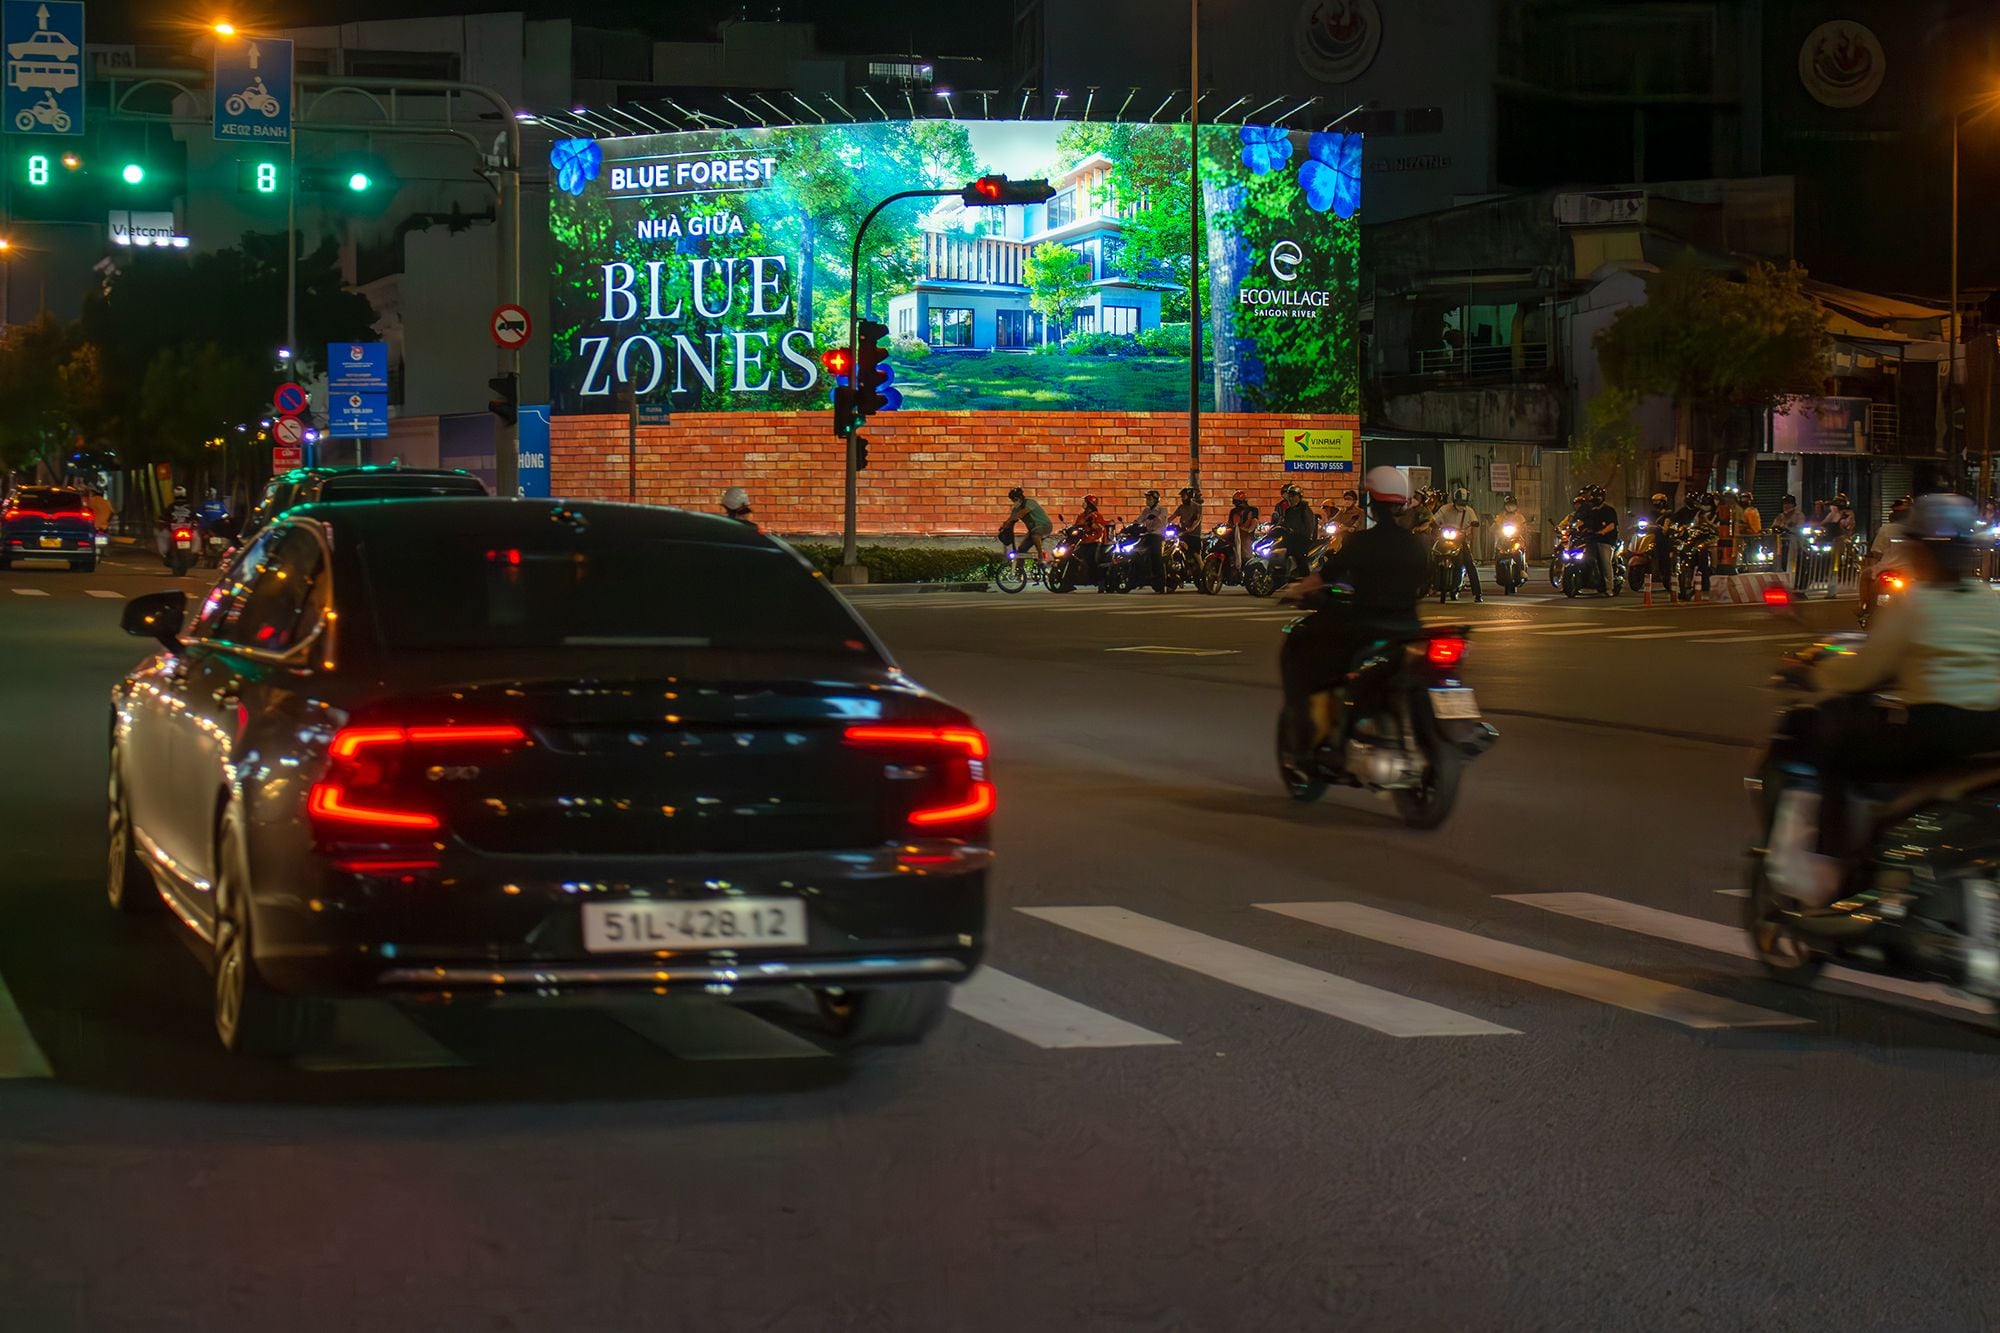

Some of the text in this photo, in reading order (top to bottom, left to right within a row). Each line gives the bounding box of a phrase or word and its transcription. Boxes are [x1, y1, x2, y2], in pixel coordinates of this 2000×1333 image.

[221, 123, 237, 135] XE
[28, 154, 48, 186] 8
[257, 163, 276, 192] 8
[611, 158, 776, 190] BLUE FOREST
[637, 211, 744, 239] NHÀ GIỮA
[600, 255, 790, 323] BLUE
[1240, 288, 1330, 307] ECOVILLAGE
[1254, 308, 1316, 318] SAIGON RIVER
[579, 329, 818, 397] ZONES
[1293, 462, 1344, 470] LH: 0911 39 5555
